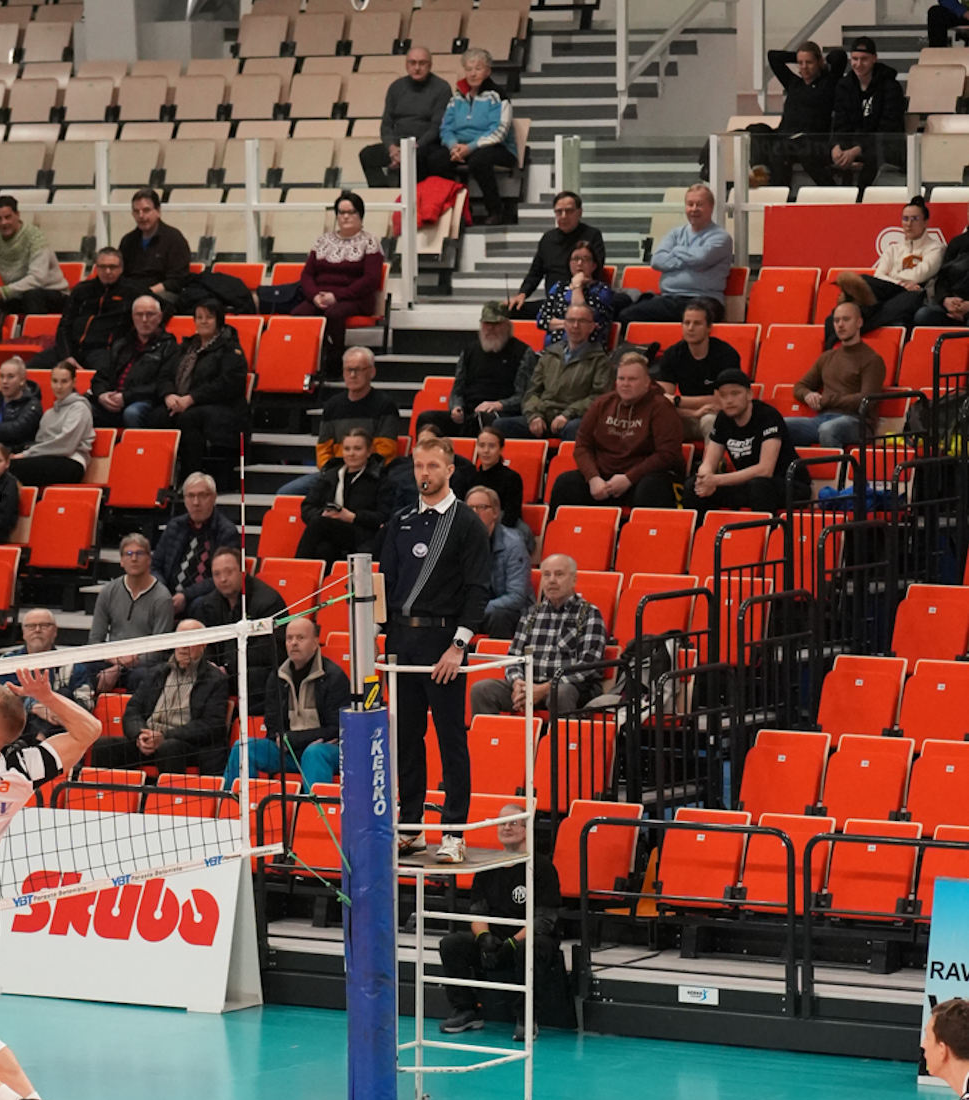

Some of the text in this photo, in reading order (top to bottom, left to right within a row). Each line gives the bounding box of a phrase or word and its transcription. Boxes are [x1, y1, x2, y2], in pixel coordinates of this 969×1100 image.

[370, 738, 387, 816] KERKO
[204, 855, 224, 868] YBT
[111, 874, 132, 887] YBT
[13, 895, 34, 908] YBT
